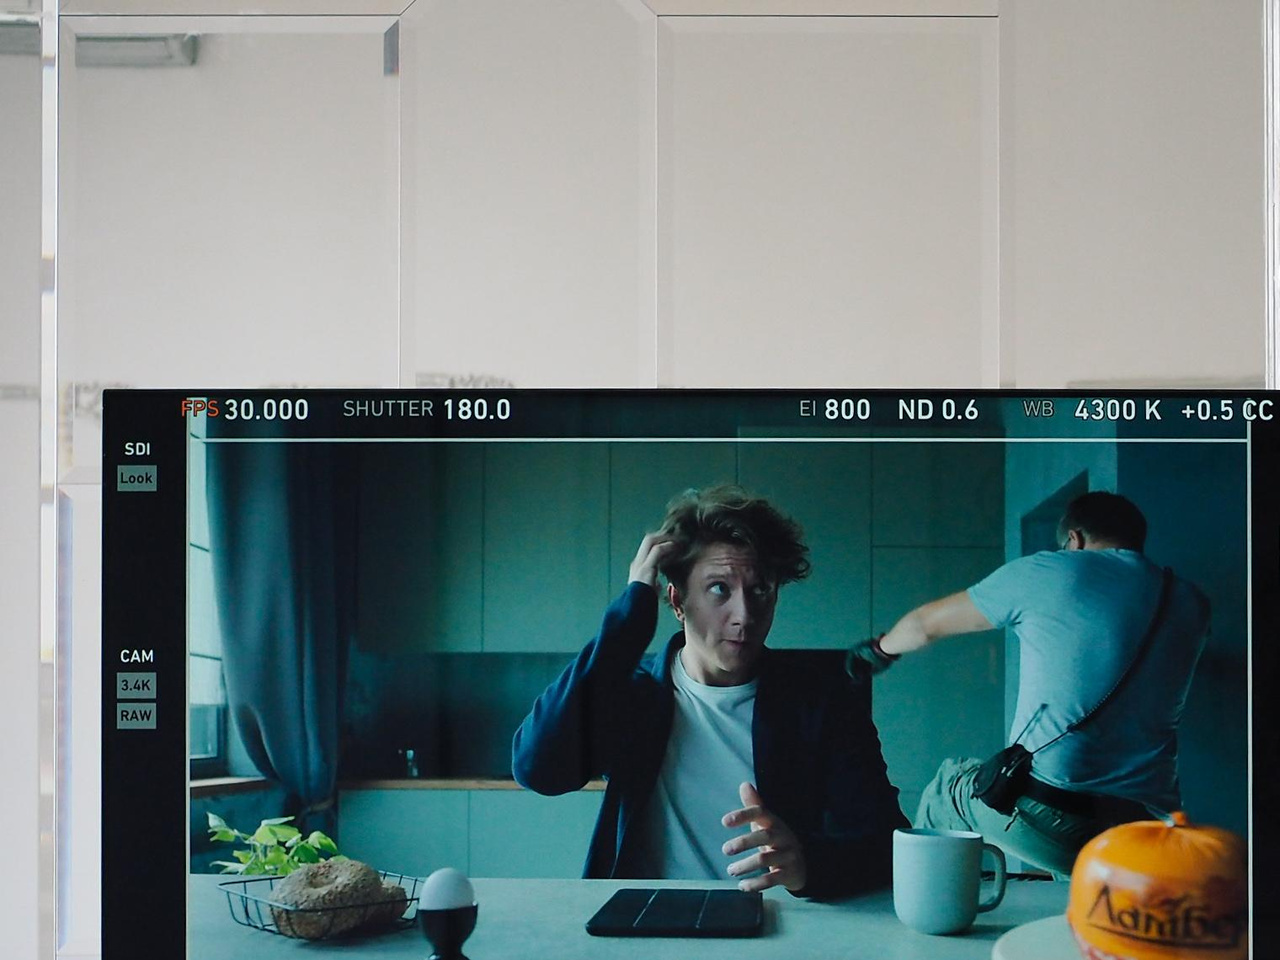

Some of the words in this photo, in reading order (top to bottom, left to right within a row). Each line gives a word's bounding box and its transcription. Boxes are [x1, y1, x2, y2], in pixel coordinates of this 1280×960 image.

[181, 400, 219, 418] FPS
[224, 399, 310, 421] 30.000
[342, 400, 434, 418] SHUTTER
[443, 399, 512, 421] 180.0
[800, 400, 817, 418] EI
[824, 399, 871, 421] 800
[898, 399, 935, 421] ND
[942, 399, 979, 421] 0.6
[1023, 400, 1056, 418] WB
[1074, 399, 1138, 421] 4300
[1145, 399, 1163, 421] K
[1181, 400, 1235, 422] +0.5
[1241, 399, 1275, 422] CC
[124, 442, 151, 456] SDI
[120, 471, 153, 484] Look
[120, 650, 154, 663] CAM
[121, 679, 151, 692] 3.4K
[121, 709, 152, 722] RAW
